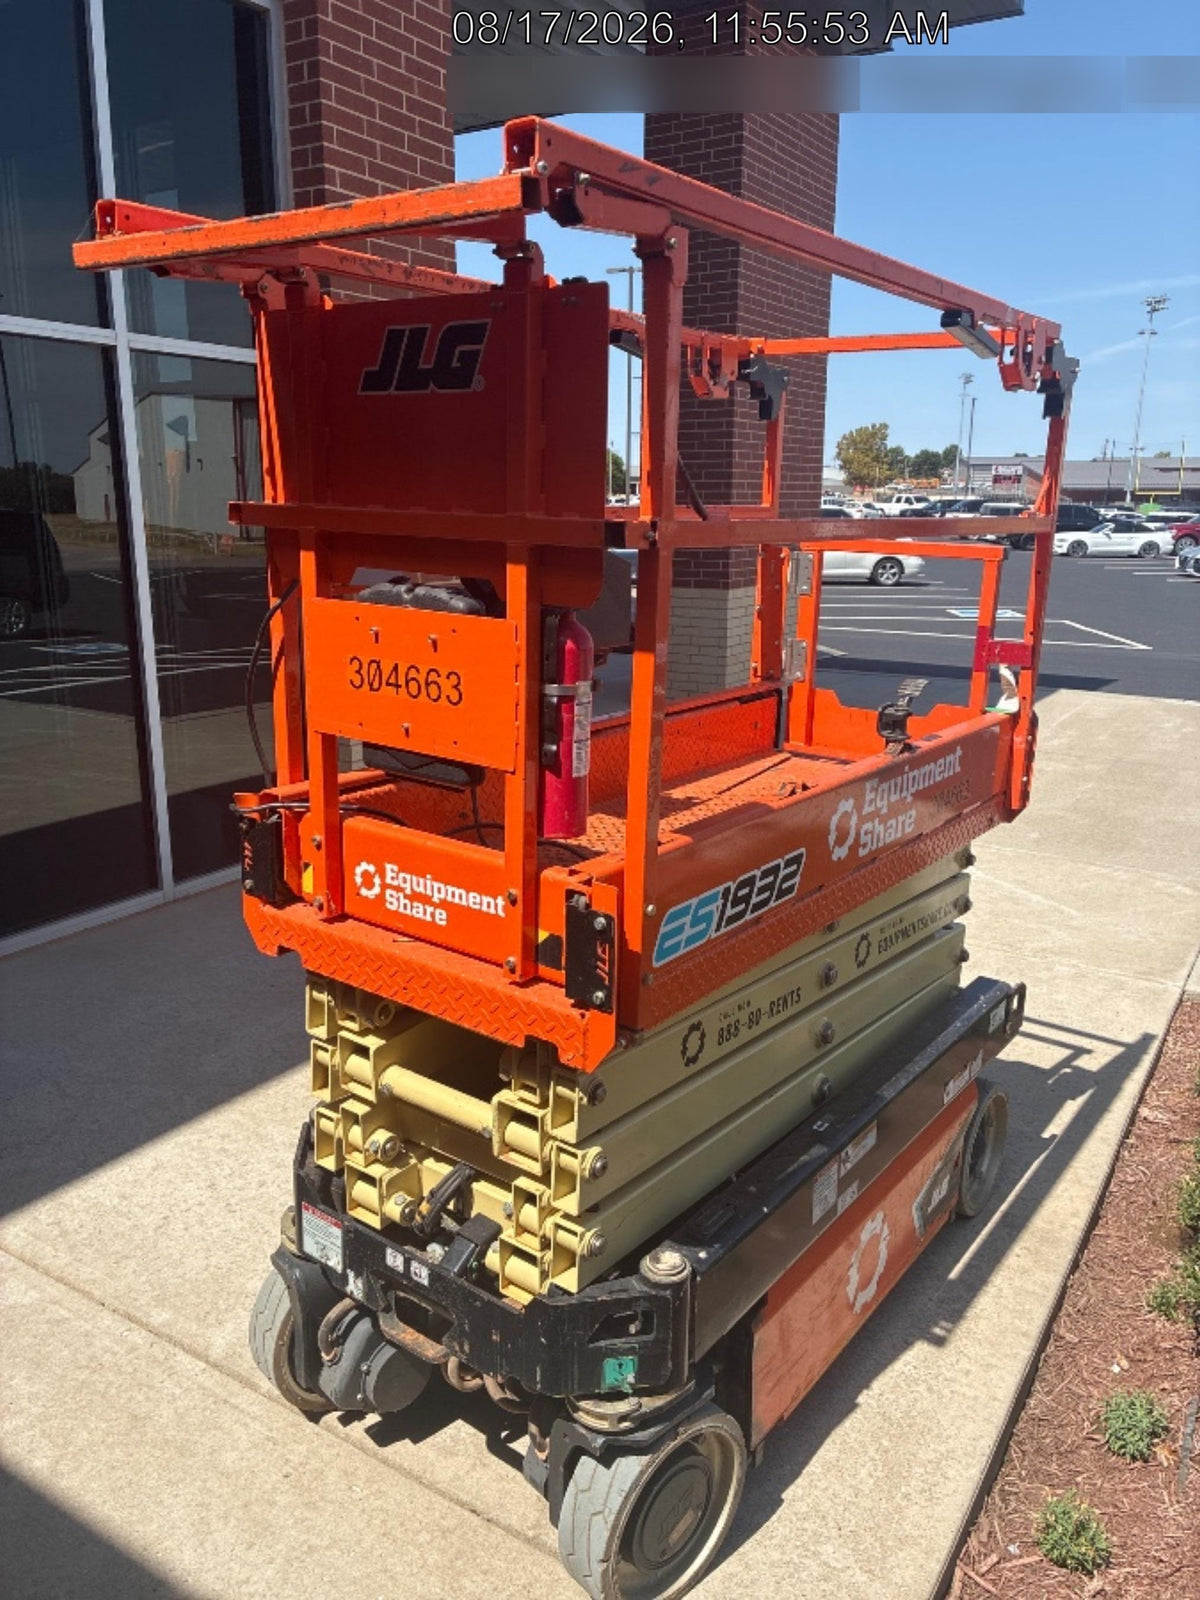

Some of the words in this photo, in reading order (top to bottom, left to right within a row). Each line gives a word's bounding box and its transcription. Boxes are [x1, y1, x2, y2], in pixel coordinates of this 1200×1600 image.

[358, 318, 492, 395] JLG
[349, 655, 463, 706] 304663
[861, 745, 962, 816] Equipment
[858, 809, 916, 858] Share
[384, 862, 506, 918] Equipment
[384, 888, 448, 926] Share
[652, 847, 806, 968] ES1932
